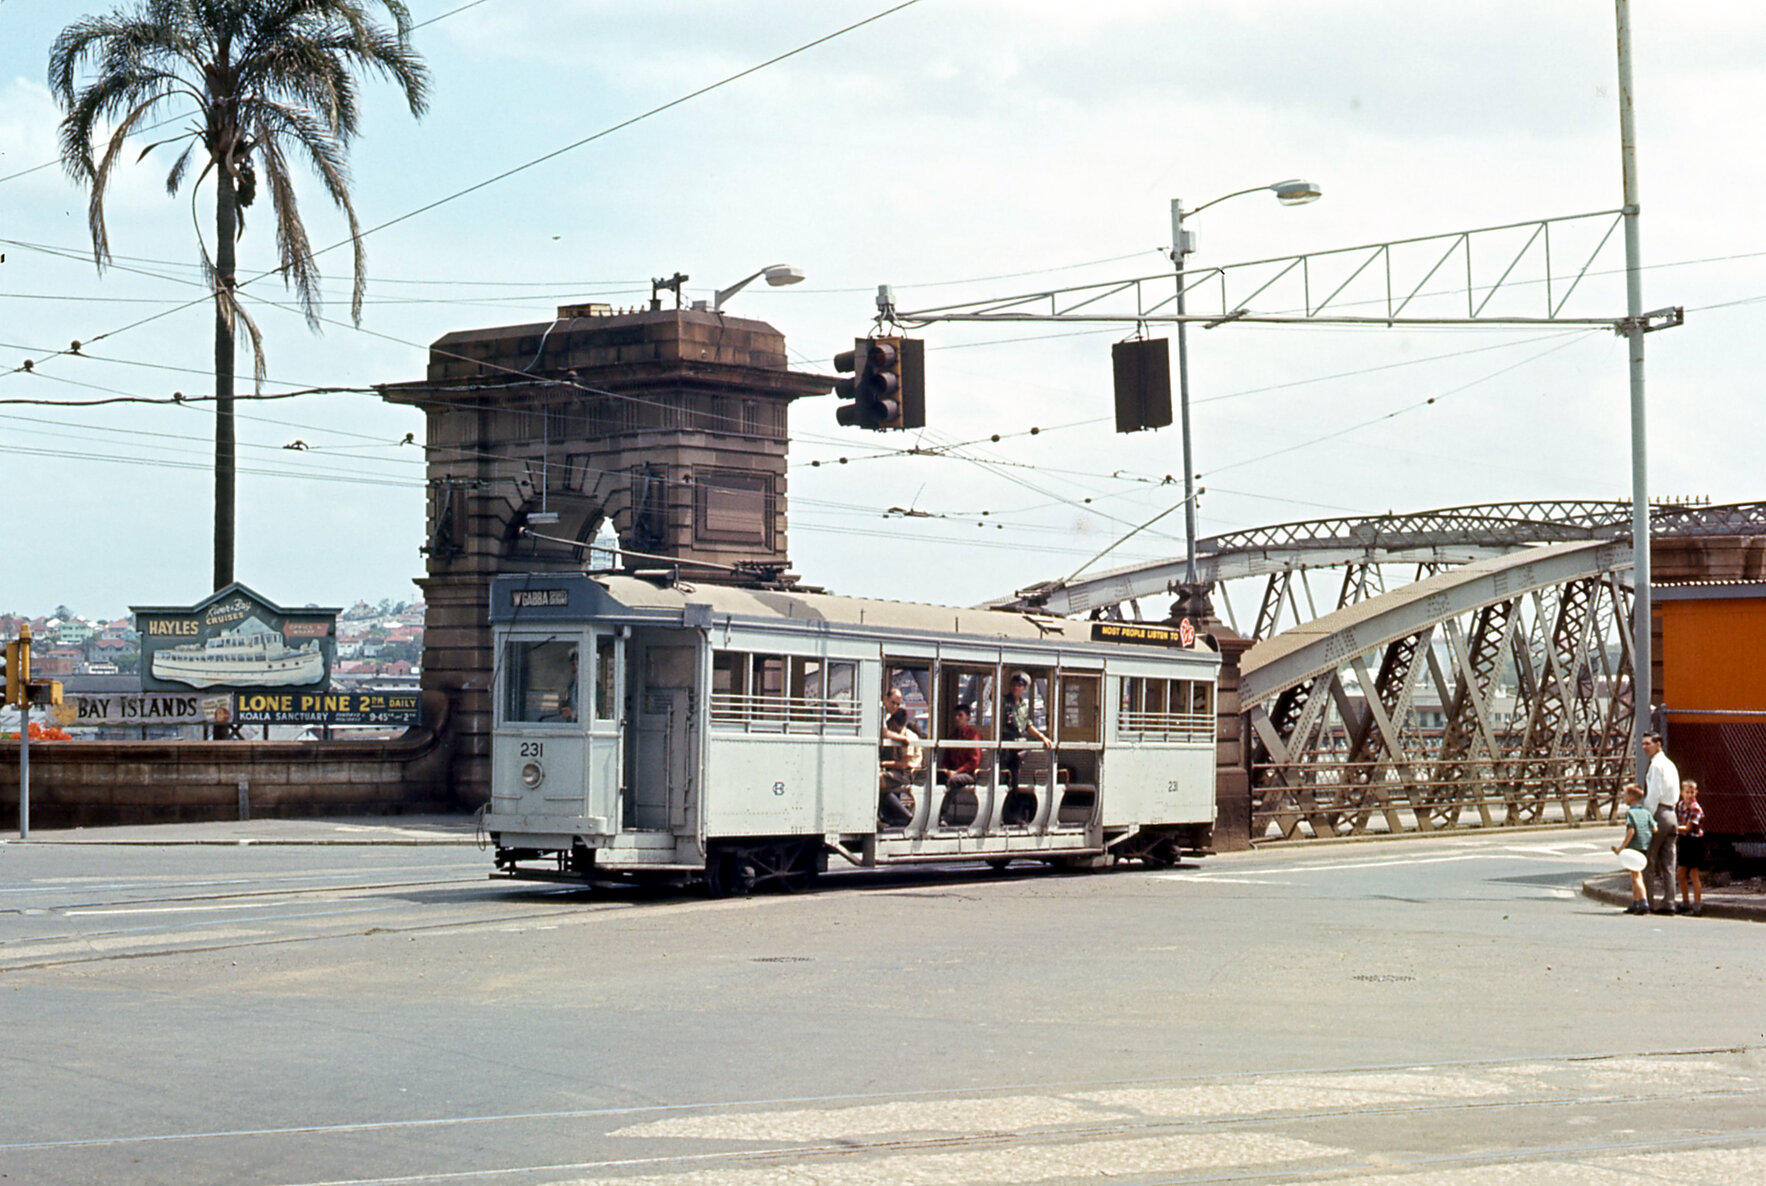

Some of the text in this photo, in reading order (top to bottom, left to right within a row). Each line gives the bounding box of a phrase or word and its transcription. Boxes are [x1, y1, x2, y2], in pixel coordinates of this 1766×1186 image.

[206, 612, 244, 625] CRUISES
[149, 620, 199, 635] HAYLES
[1101, 626, 1179, 641] MOST PEOPLE LISTEN TO
[77, 698, 111, 718] BAY
[120, 696, 197, 718] ISLANDS
[239, 695, 293, 712] LONE
[301, 695, 351, 712] PINE
[388, 699, 416, 708] DAILY
[240, 712, 271, 721] KOALA
[275, 712, 328, 721] SANCTUARY
[520, 742, 543, 757] 231
